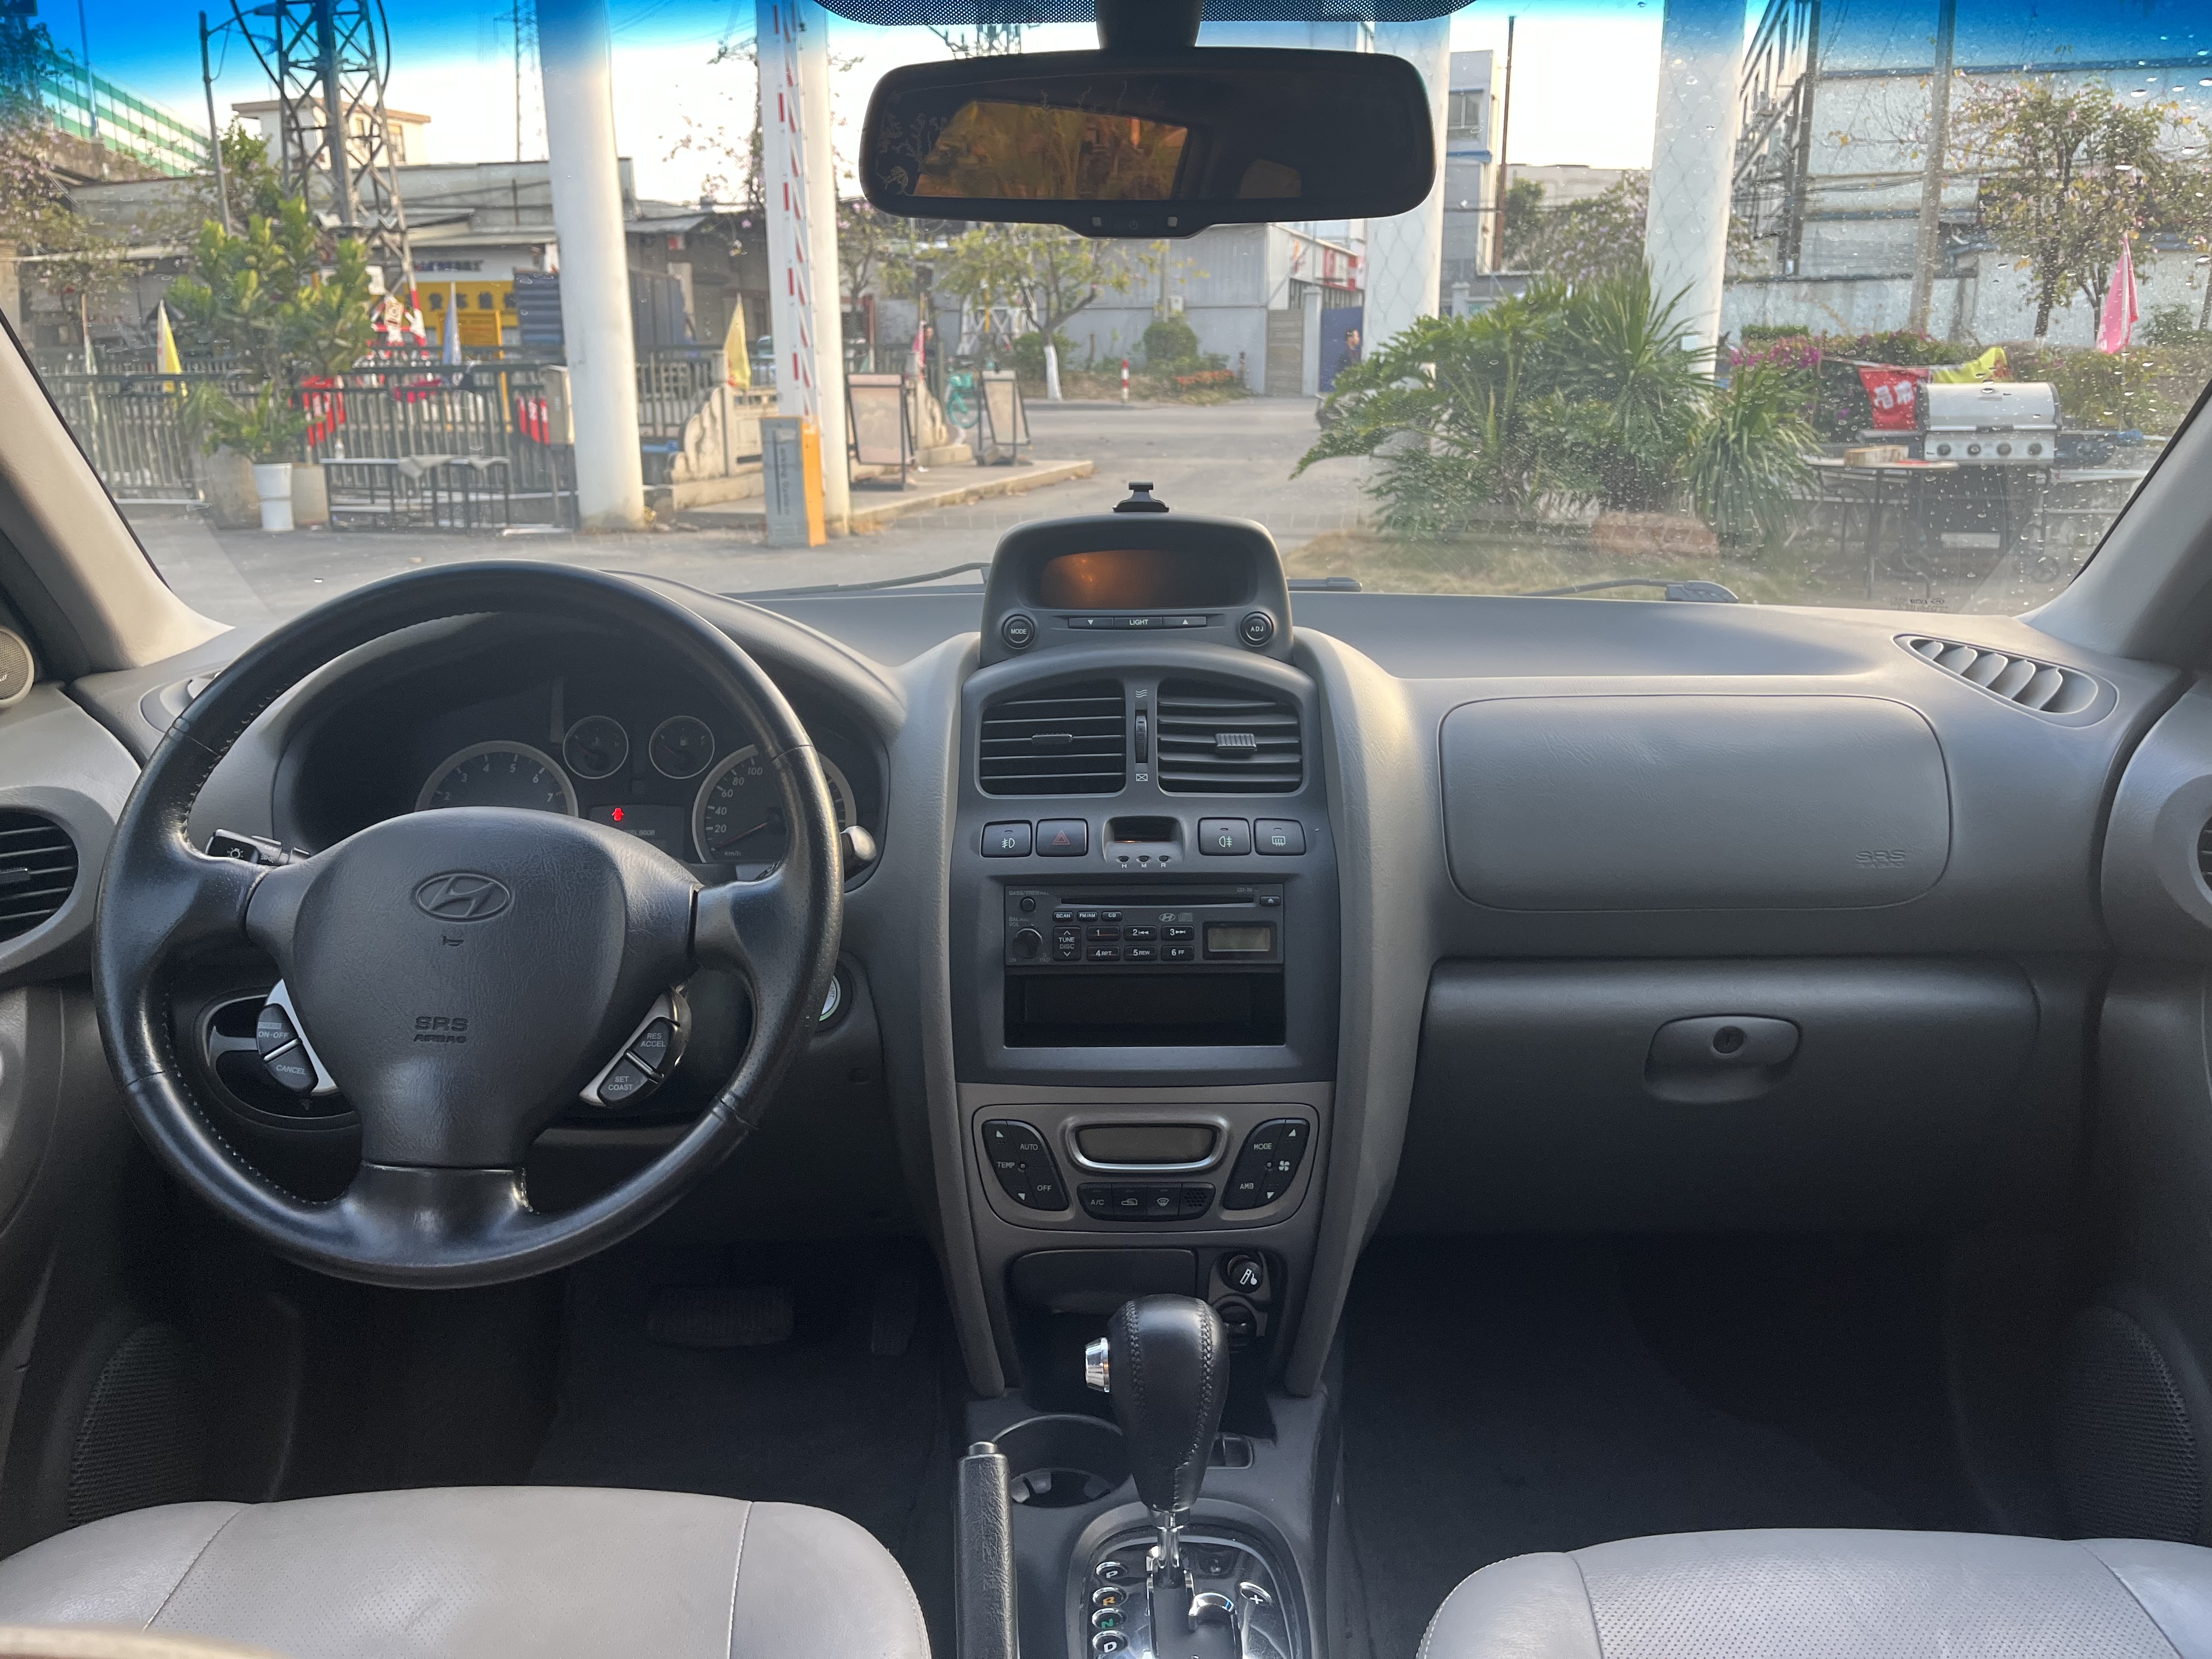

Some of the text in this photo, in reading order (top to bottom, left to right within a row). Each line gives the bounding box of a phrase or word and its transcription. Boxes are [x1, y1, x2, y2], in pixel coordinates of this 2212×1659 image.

[510, 764, 516, 773] 5
[748, 767, 763, 775] 100
[533, 774, 539, 783] 6
[732, 777, 744, 786] 80
[547, 793, 554, 802] 7
[721, 788, 733, 798] 60
[715, 806, 727, 815] 40
[714, 824, 727, 833] 20
[1855, 850, 1906, 863] SRS
[415, 1016, 468, 1031] SRS
[276, 1064, 306, 1075] CANCEL
[1105, 1570, 1118, 1578] P
[1103, 1596, 1115, 1606] R
[1101, 1618, 1114, 1629] N
[1103, 1641, 1117, 1653] D
